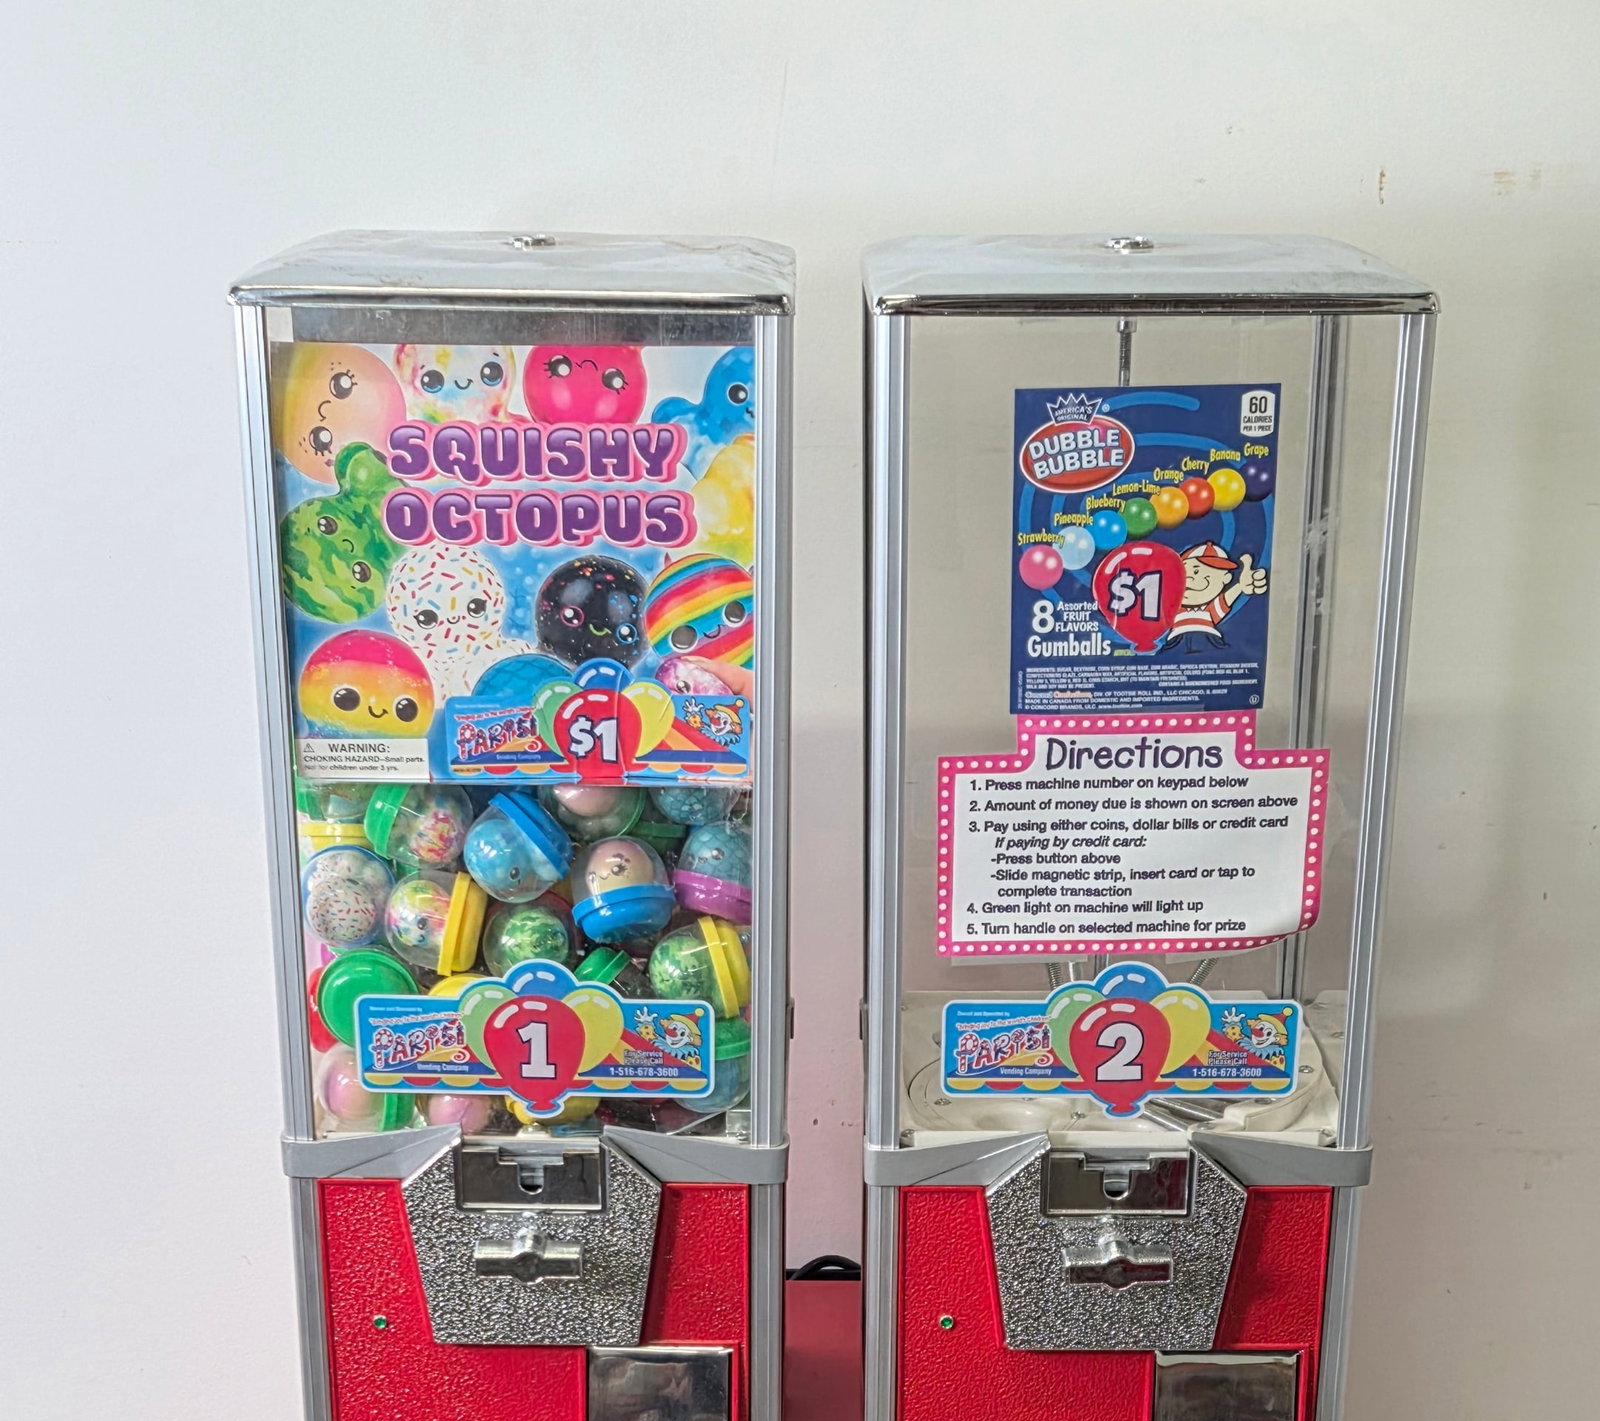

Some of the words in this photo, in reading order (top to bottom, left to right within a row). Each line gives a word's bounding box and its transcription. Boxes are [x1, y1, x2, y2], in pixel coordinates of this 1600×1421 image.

[1054, 405, 1092, 416] AMERICA'S
[1250, 396, 1268, 413] 60
[1243, 416, 1272, 424] CALORIES
[1029, 429, 1120, 460] DUBBLE
[1244, 443, 1269, 457] Grape
[388, 424, 682, 485] SQUISHY
[1210, 449, 1240, 462] Banana
[1034, 449, 1124, 479] BUBBLE
[1182, 457, 1209, 474] Cherry
[1153, 467, 1184, 483] Orange
[1113, 480, 1160, 496] Lemon-Lime
[1086, 495, 1126, 512] Blueberry
[383, 490, 693, 547] OCTOPUS
[1054, 513, 1093, 526] Pineapple
[1018, 528, 1065, 548] Strawberry
[1108, 568, 1162, 621] $1
[1032, 600, 1054, 633] 8
[1057, 601, 1097, 611] Assorted
[1064, 611, 1091, 621] FRUIT
[1056, 622, 1099, 632] FLAVORS
[1028, 633, 1111, 657] Gumballs
[568, 715, 618, 763] $1
[328, 743, 390, 753] WARNING:
[1045, 736, 1223, 771] Directions
[971, 780, 981, 790] 1.
[985, 779, 1022, 790] Press
[1026, 778, 1080, 789] machine
[1084, 777, 1134, 788] number
[1137, 779, 1153, 788] on
[1158, 776, 1205, 790] keypad
[1209, 776, 1249, 787] below
[969, 800, 981, 812] 2.
[984, 800, 1036, 811] Amount
[1039, 799, 1052, 810] of
[1055, 800, 1099, 812] money
[1102, 798, 1127, 809] due
[1130, 798, 1141, 808] is
[1145, 798, 1187, 808] shown
[1191, 799, 1208, 808] on
[1211, 798, 1254, 808] screen
[1258, 796, 1298, 807] above
[969, 821, 980, 832] 3.
[984, 821, 1009, 834] Pay
[1013, 820, 1046, 833] using
[1050, 819, 1087, 830] either
[1091, 819, 1128, 832] coins,
[1133, 819, 1169, 830] dollar
[1173, 818, 1199, 829] bills
[1203, 819, 1217, 829] or
[1220, 817, 1256, 828] credit
[1259, 816, 1288, 827] card
[995, 837, 1005, 848] If
[1006, 837, 1050, 850] paying
[1053, 836, 1069, 849] by
[1072, 836, 1110, 847] credit
[1113, 836, 1147, 847] card:
[991, 853, 1032, 864] -Press
[1036, 853, 1077, 864] button
[1081, 853, 1121, 864] above
[991, 869, 1028, 880] -Slide
[1032, 869, 1090, 882] magnetic
[1094, 869, 1125, 882] strip,
[1130, 869, 1165, 880] insert
[1169, 867, 1197, 878] card
[1201, 868, 1215, 878] or
[1218, 867, 1238, 879] tap
[1242, 866, 1255, 876] to
[998, 886, 1057, 899] complete
[1061, 886, 1132, 896] transaction
[967, 903, 978, 913] 4.
[982, 902, 1020, 913] Green
[1024, 902, 1051, 915] light
[1055, 904, 1070, 913] on
[1074, 902, 1128, 913] machine
[1133, 901, 1152, 912] will
[1156, 900, 1183, 913] light
[1188, 901, 1203, 913] up
[967, 924, 978, 934] 5.
[981, 923, 1009, 934] Turn
[1014, 922, 1055, 934] handle
[1059, 924, 1074, 933] on
[1078, 922, 1132, 933] selected
[1136, 920, 1190, 932] machine
[1194, 920, 1212, 931] for
[1215, 919, 1246, 933] prize
[517, 1021, 556, 1079] 1
[1096, 1021, 1145, 1082] 2
[610, 1067, 679, 1076] 1-516-678-3600
[1000, 1067, 1023, 1075] Vending
[1024, 1067, 1052, 1076] Company
[1192, 1068, 1262, 1077] 1-516-678-3600
